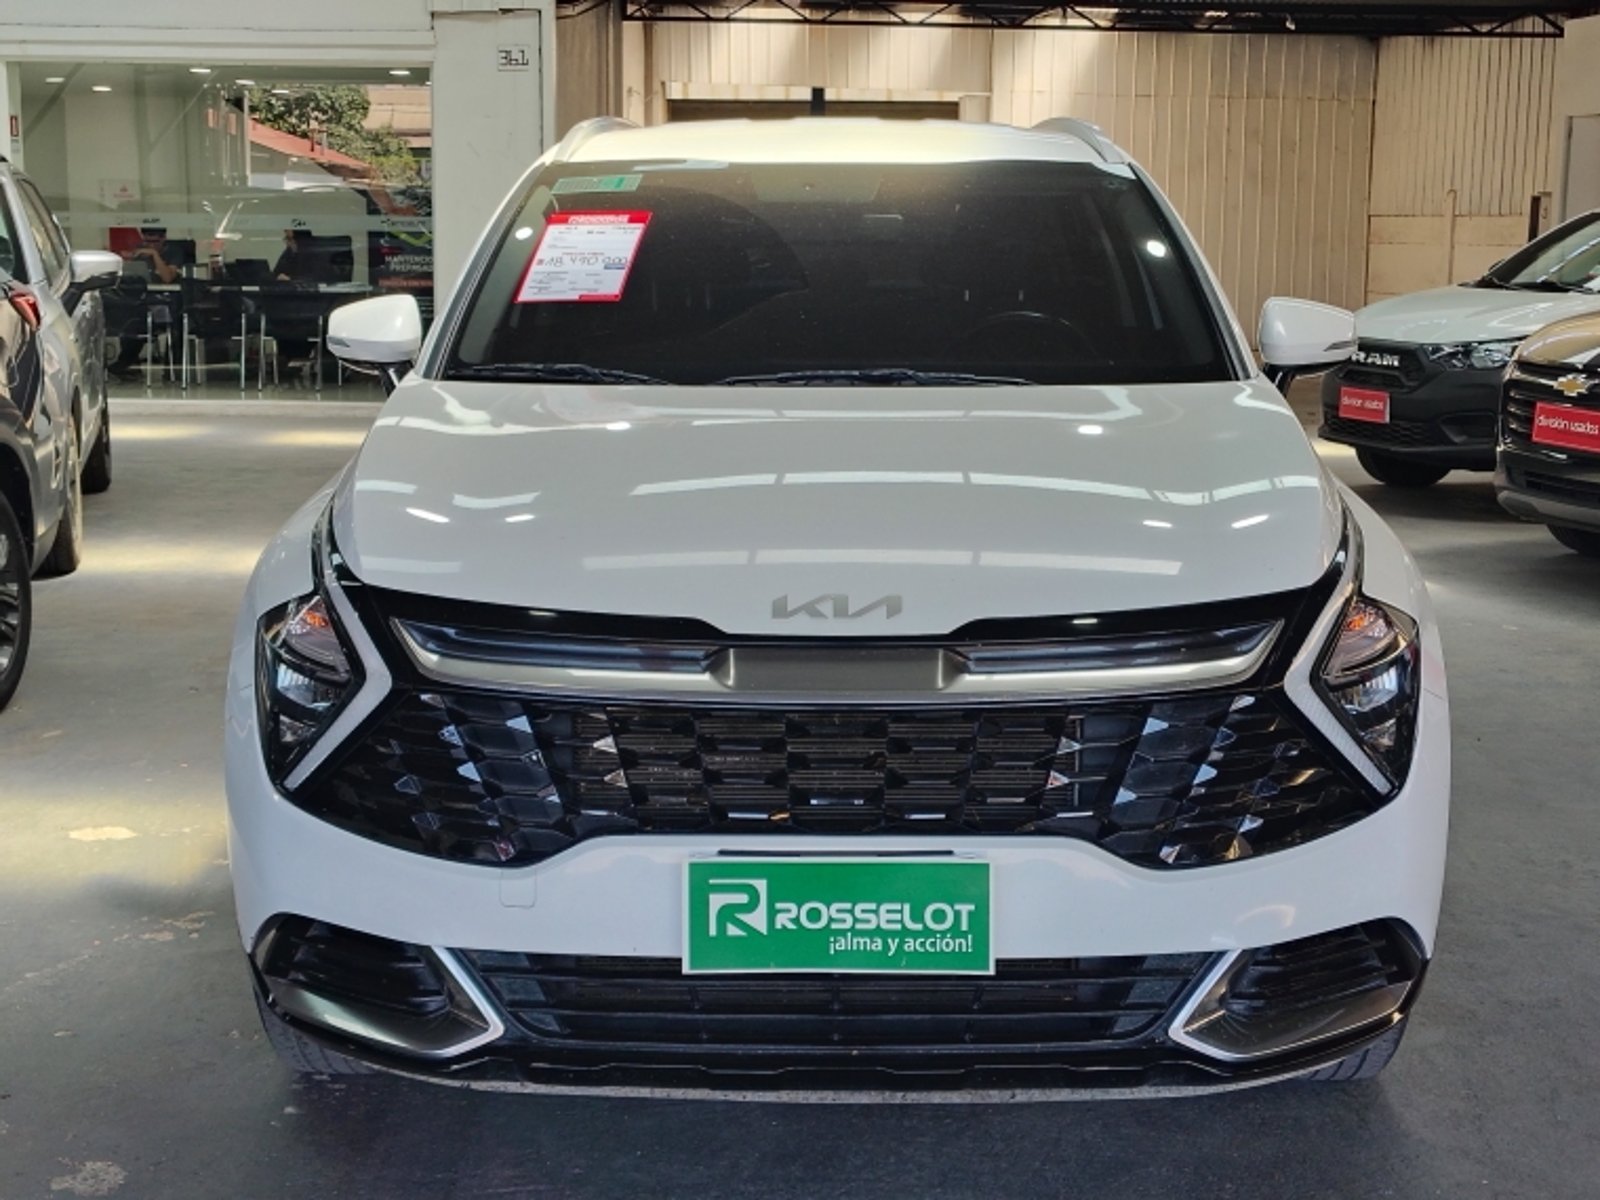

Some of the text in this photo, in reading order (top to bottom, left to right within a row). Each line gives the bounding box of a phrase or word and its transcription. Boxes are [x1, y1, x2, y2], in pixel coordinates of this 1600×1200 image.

[772, 594, 903, 619] KIA
[774, 901, 976, 931] ROSSELOT
[828, 932, 973, 956] ¡alma y acción!
